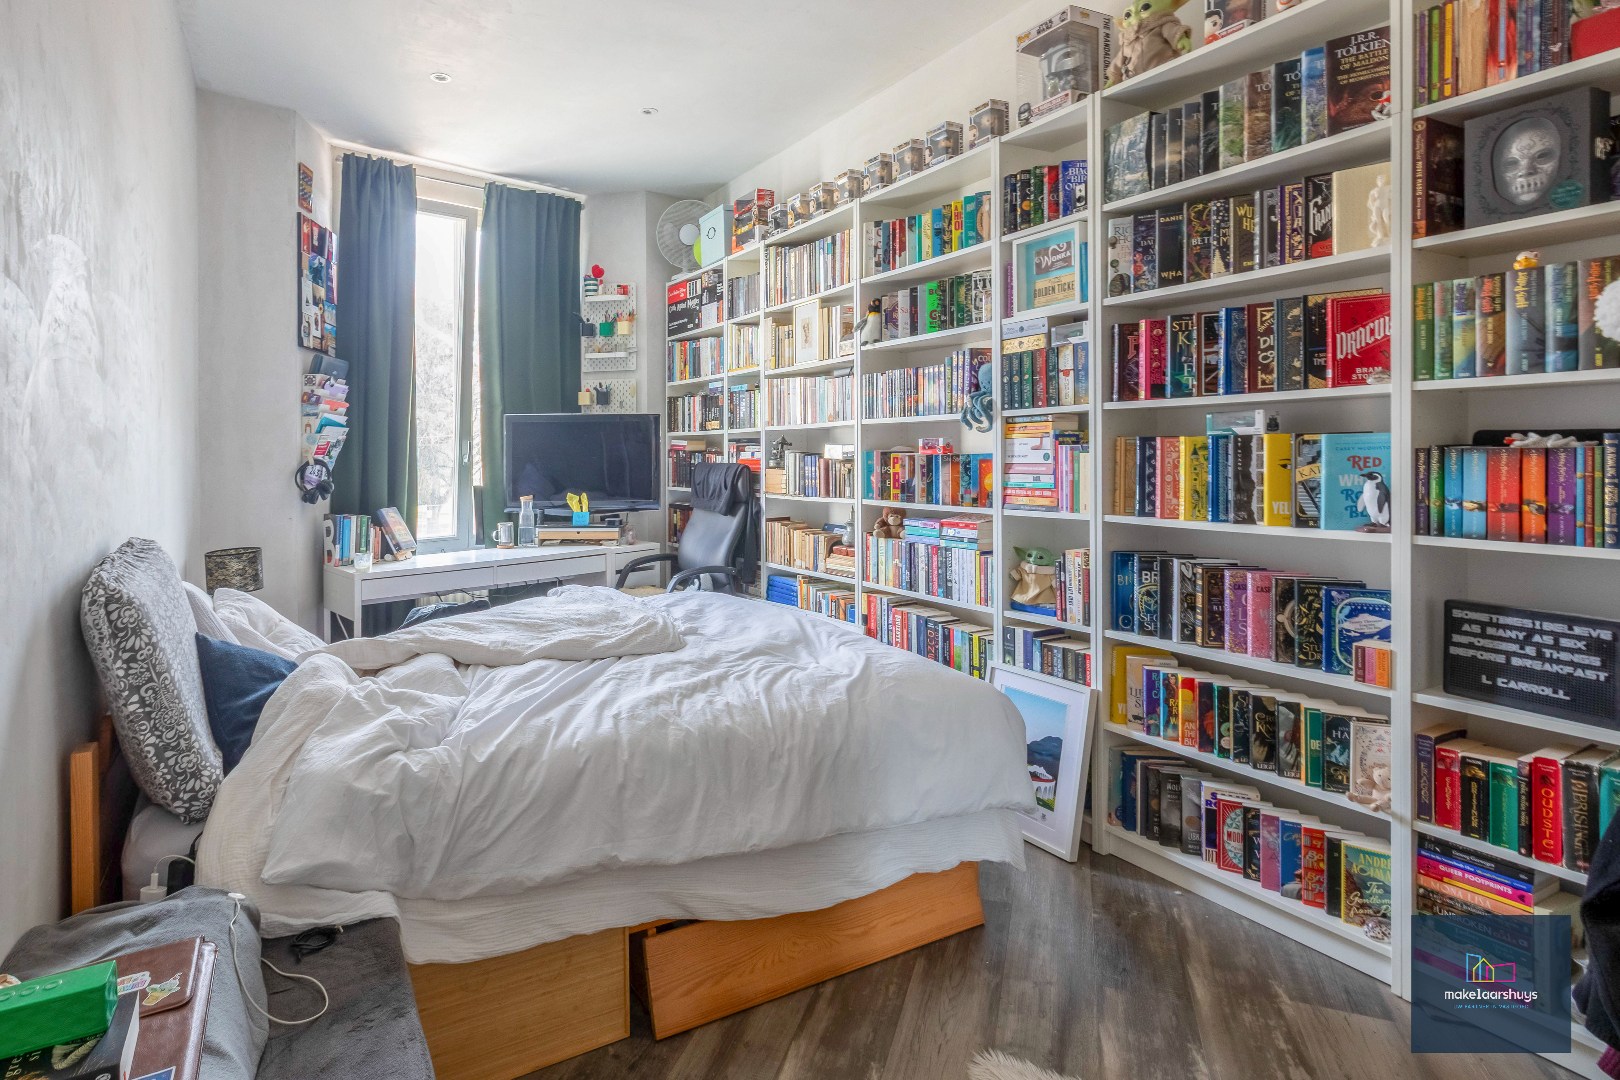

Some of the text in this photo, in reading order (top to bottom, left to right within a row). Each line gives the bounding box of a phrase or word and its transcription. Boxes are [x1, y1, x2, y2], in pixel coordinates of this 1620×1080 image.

[1334, 39, 1391, 58] TOLKIEN
[1035, 241, 1071, 269] WONKA
[1033, 282, 1056, 299] GOLDEN
[1461, 623, 1587, 651] AS MANY AS SIX
[1451, 634, 1602, 667] IMPOSSIBLE THINGS
[1449, 645, 1609, 682] BEFORE BREAKFAST
[1496, 677, 1571, 700] CARROLL
[1365, 882, 1384, 895] The
[1429, 881, 1463, 898] MONA
[1438, 864, 1463, 878] QUEER
[1464, 872, 1513, 895] FOOTPRINTS
